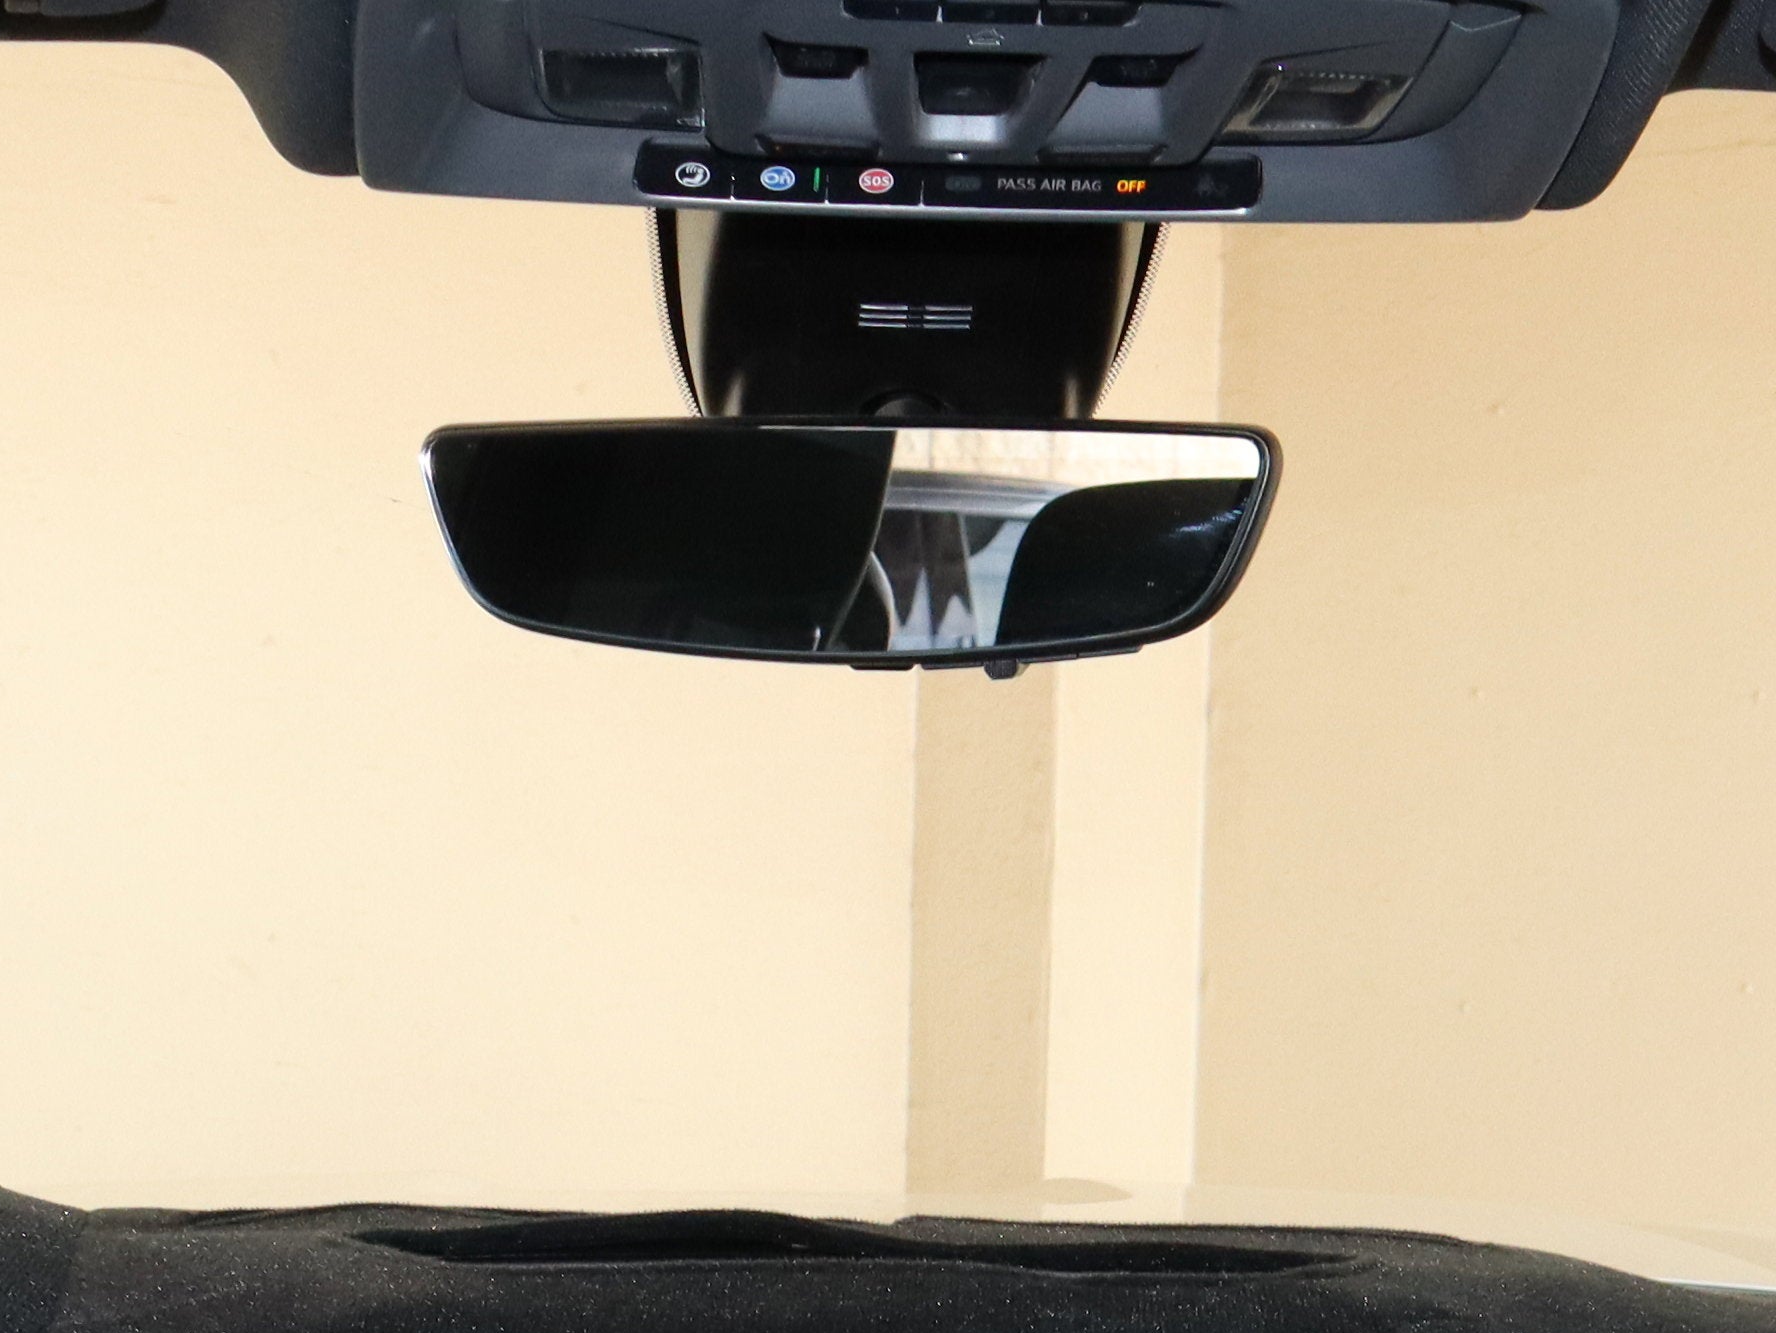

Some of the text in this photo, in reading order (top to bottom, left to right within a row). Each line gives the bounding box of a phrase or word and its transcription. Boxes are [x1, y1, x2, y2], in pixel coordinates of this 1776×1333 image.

[863, 175, 890, 187] SOS
[997, 178, 1036, 191] PASS
[1040, 178, 1067, 192] AIR
[1071, 179, 1102, 192] BAG
[1116, 179, 1146, 194] OFF
